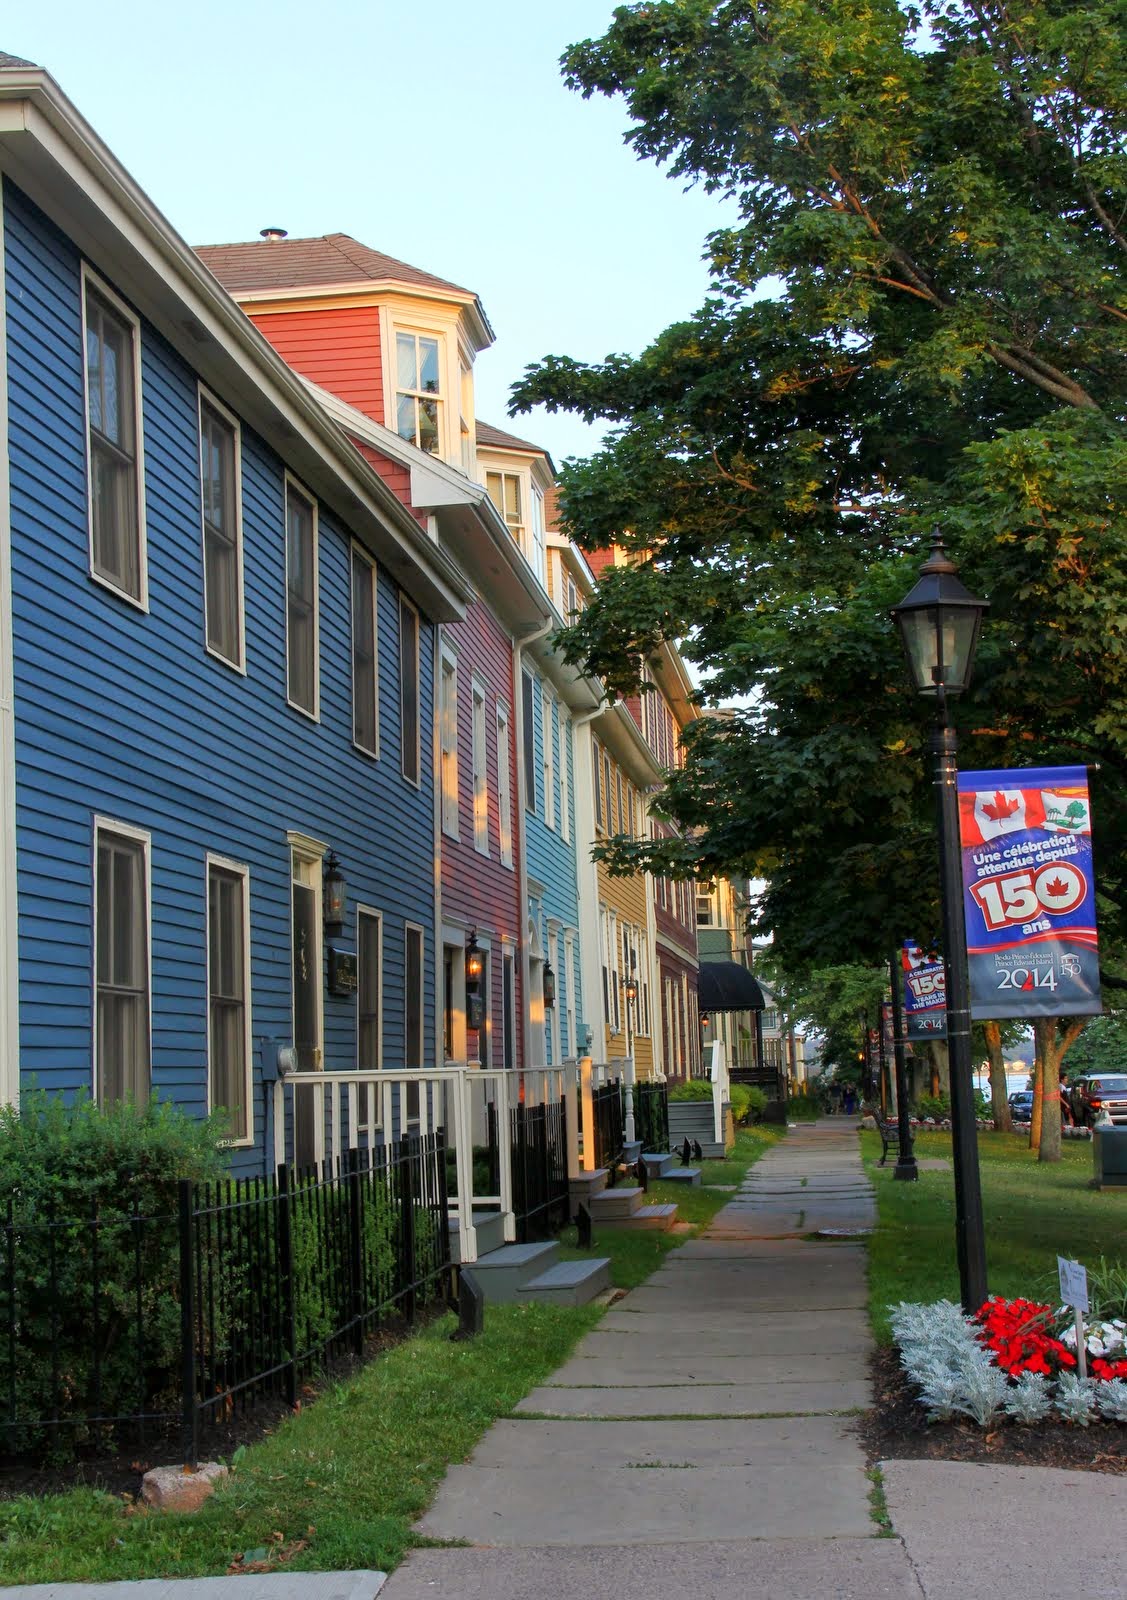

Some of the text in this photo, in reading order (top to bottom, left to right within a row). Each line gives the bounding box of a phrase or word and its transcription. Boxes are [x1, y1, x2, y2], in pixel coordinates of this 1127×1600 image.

[973, 834, 1076, 865] Une célébration
[977, 845, 1079, 877] attendue depuis
[974, 864, 1083, 926] 150
[1022, 919, 1051, 935] ans
[914, 966, 944, 976] CELEBRATIO
[996, 966, 1058, 991] 2014
[916, 993, 937, 1003] YEARS
[926, 998, 946, 1006] MAKIN
[917, 1019, 942, 1029] 2014
